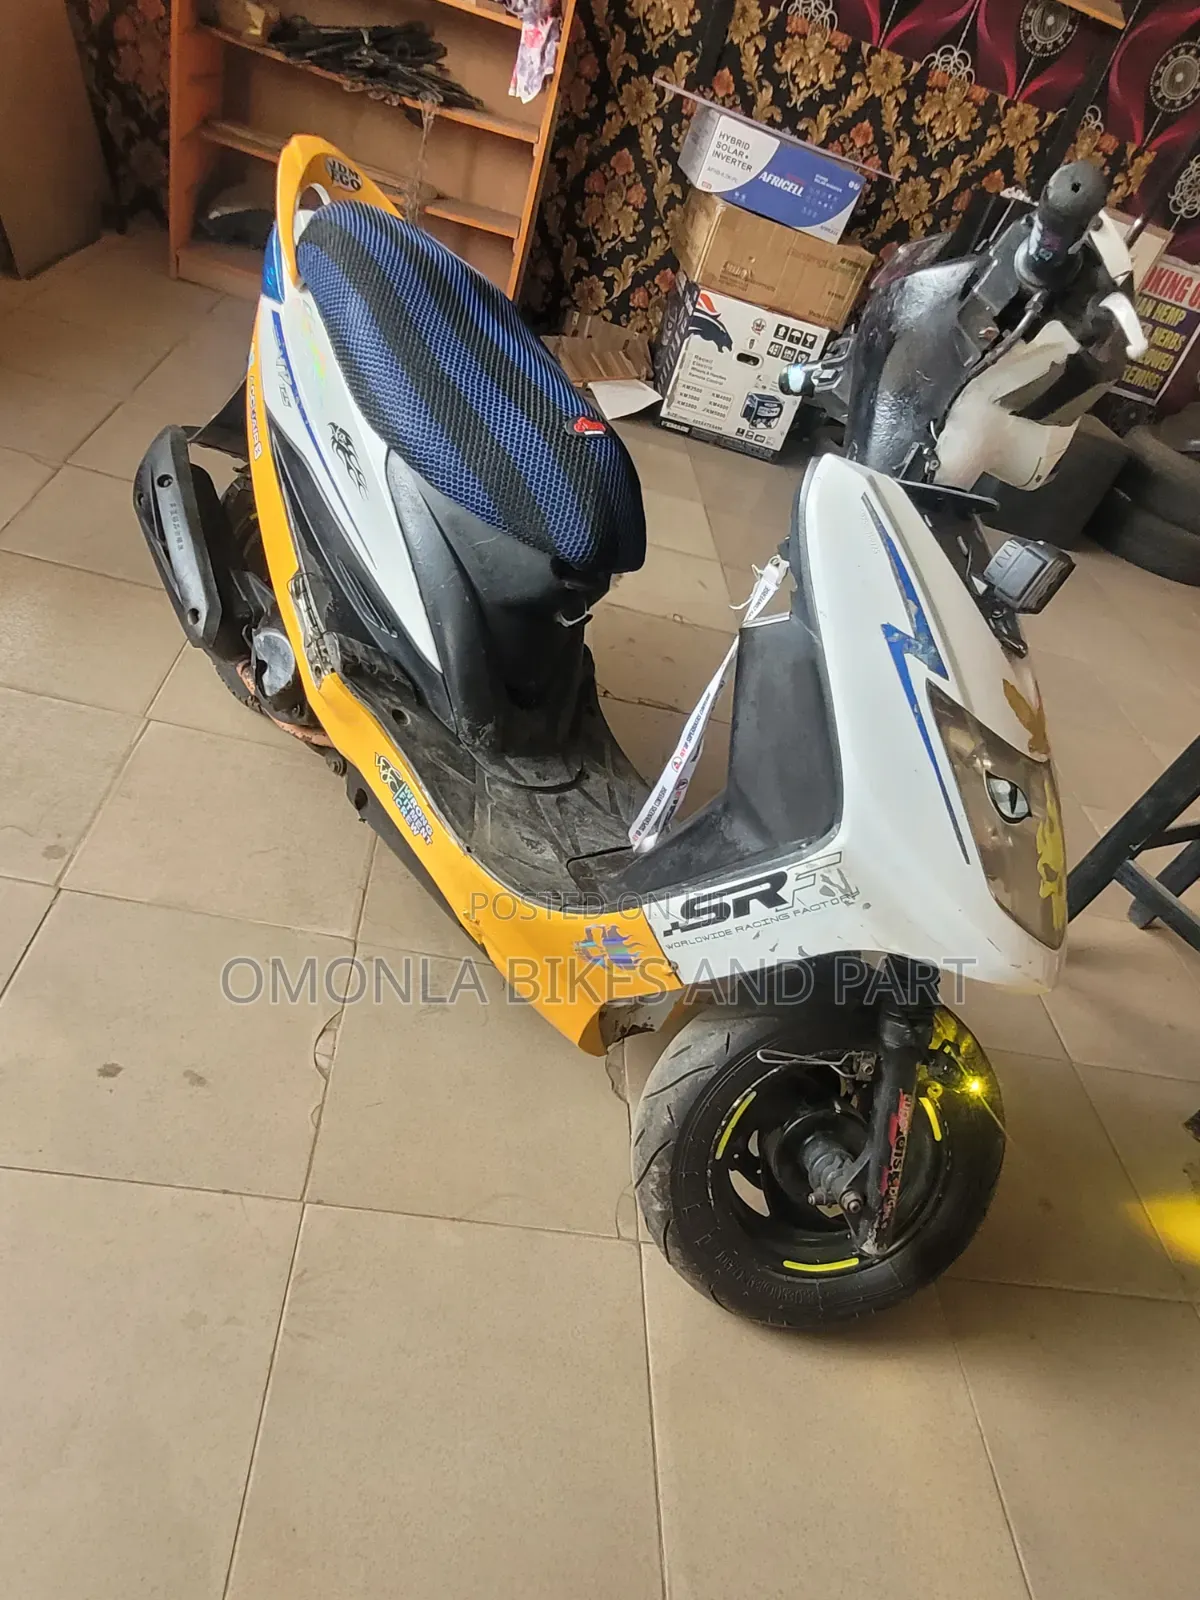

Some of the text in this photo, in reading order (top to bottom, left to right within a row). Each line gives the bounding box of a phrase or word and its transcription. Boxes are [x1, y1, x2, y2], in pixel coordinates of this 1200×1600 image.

[715, 141, 745, 158] SOLAR
[718, 131, 750, 151] HYBRID
[327, 159, 359, 180] JDM
[712, 150, 753, 172] INVERTER
[758, 171, 804, 197] AFRICELL
[1152, 302, 1187, 327] HEMP
[1151, 327, 1187, 352] HERBS
[395, 798, 420, 836] CREW
[398, 791, 433, 845] FITMENT
[403, 785, 433, 836] WRONG
[665, 884, 860, 951] WORLDWIDE RACING FACTORY
